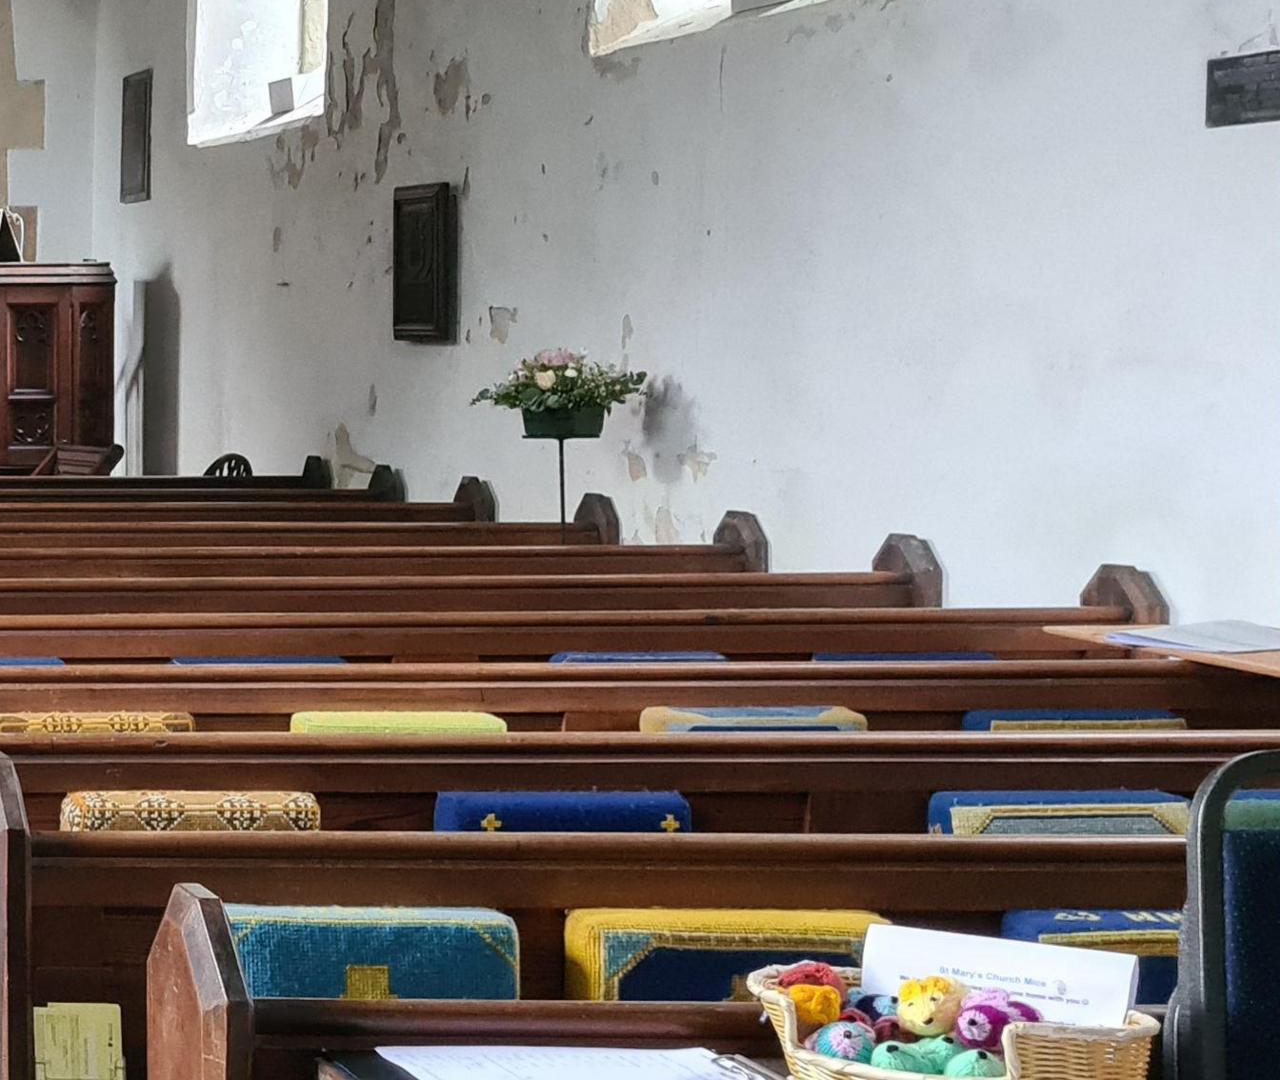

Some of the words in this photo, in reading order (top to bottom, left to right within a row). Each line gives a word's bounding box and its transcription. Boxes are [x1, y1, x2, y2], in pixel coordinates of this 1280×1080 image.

[952, 967, 983, 980] Mary's
[986, 971, 1021, 984] Church
[1024, 976, 1047, 988] Mice
